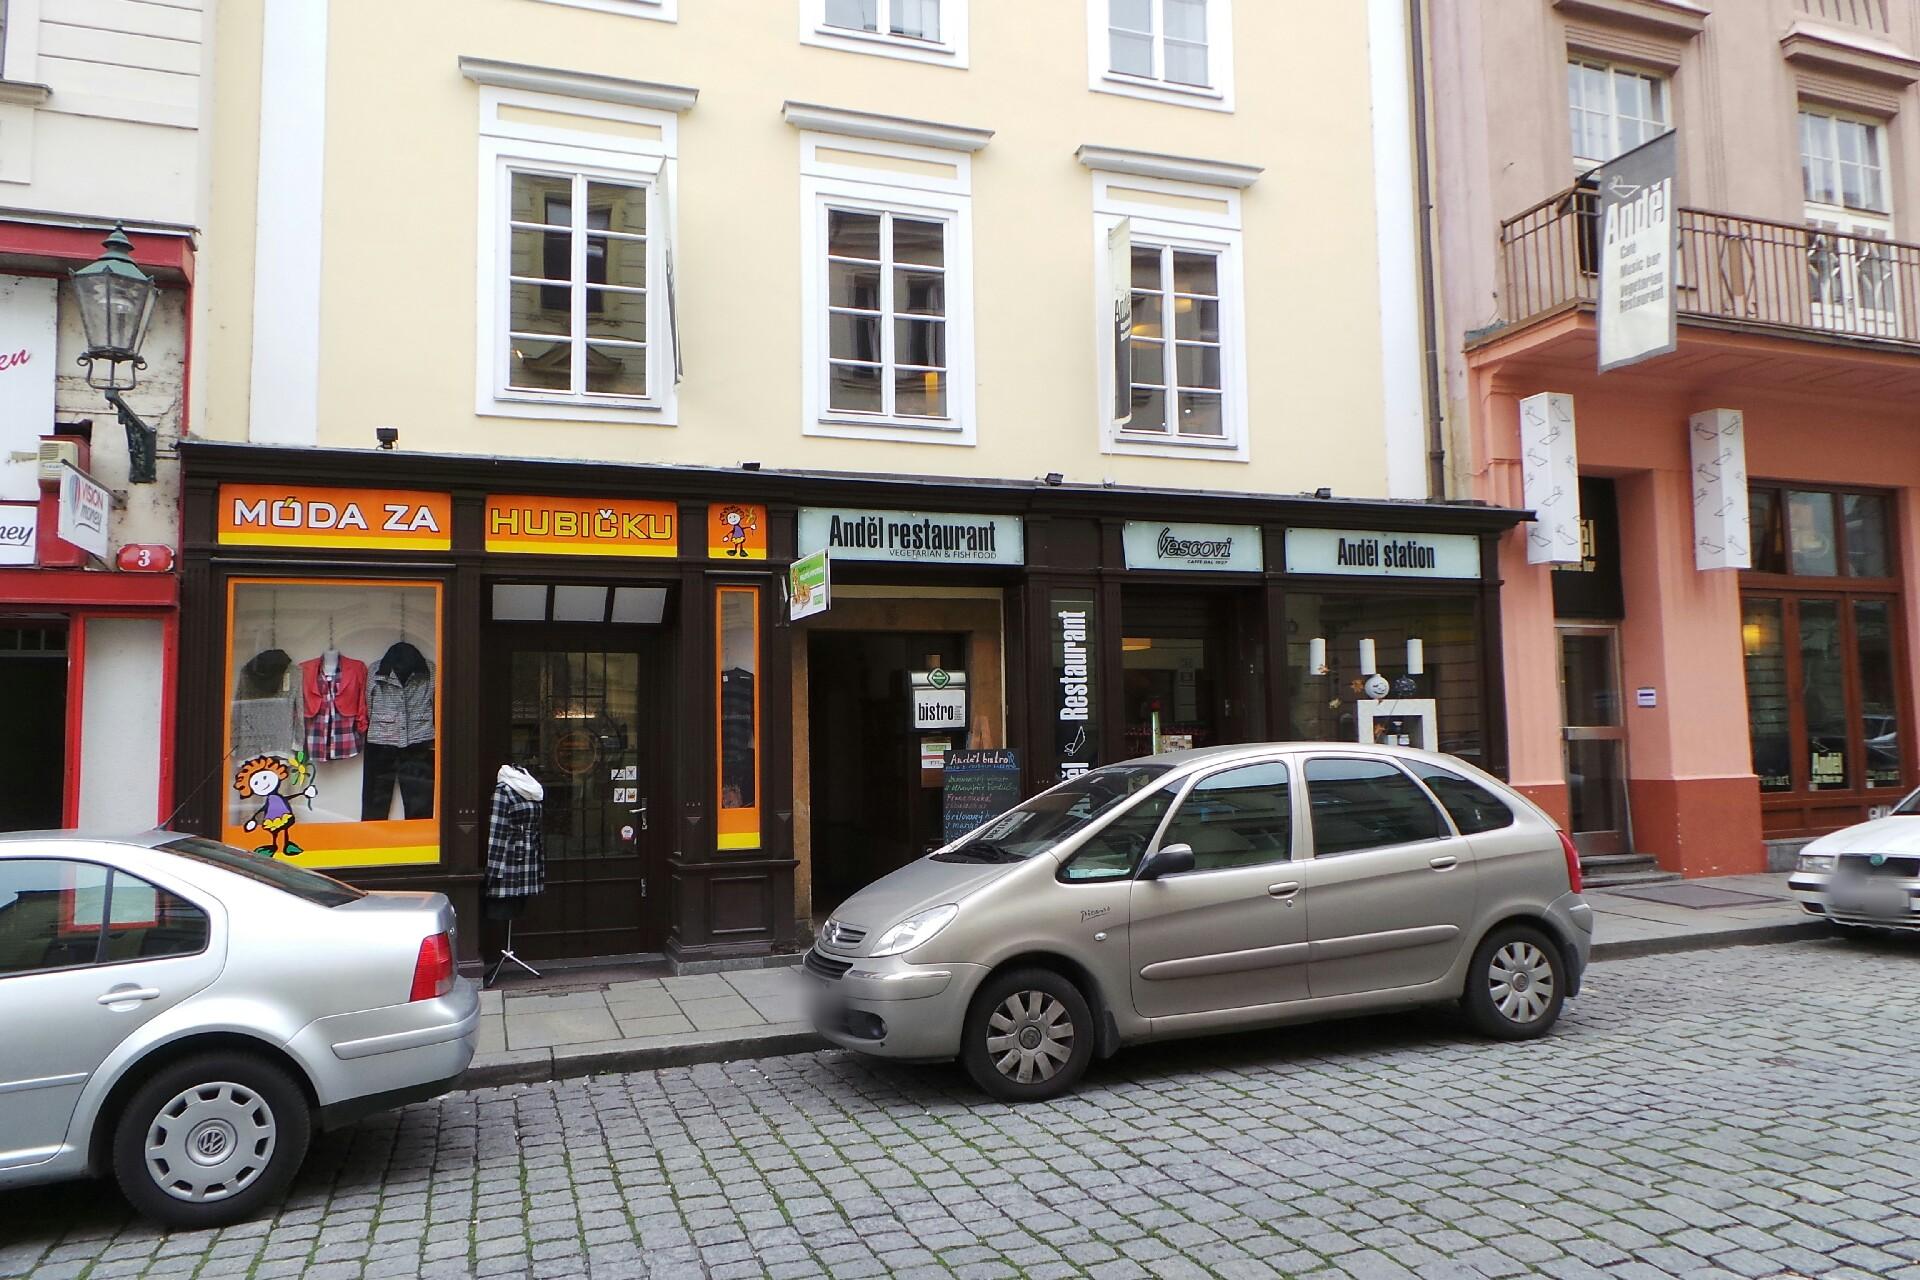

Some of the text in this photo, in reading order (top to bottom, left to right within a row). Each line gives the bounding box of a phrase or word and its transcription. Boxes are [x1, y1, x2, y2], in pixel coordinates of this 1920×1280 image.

[1605, 177, 1671, 244] Anděl
[81, 480, 104, 510] VISION
[80, 504, 103, 532] money
[233, 496, 440, 533] MÓDA ZA
[490, 508, 673, 539] HUBIČKU
[829, 514, 996, 552] Anděl restaurant
[1157, 527, 1232, 559] Vescovi
[138, 549, 150, 567] 3
[889, 549, 997, 560] VEGETARIAN & FISH FOOD
[1337, 538, 1436, 569] Anděl station
[1058, 611, 1089, 721] Restaurant
[918, 702, 954, 721] bistro
[982, 751, 1008, 764] bistro
